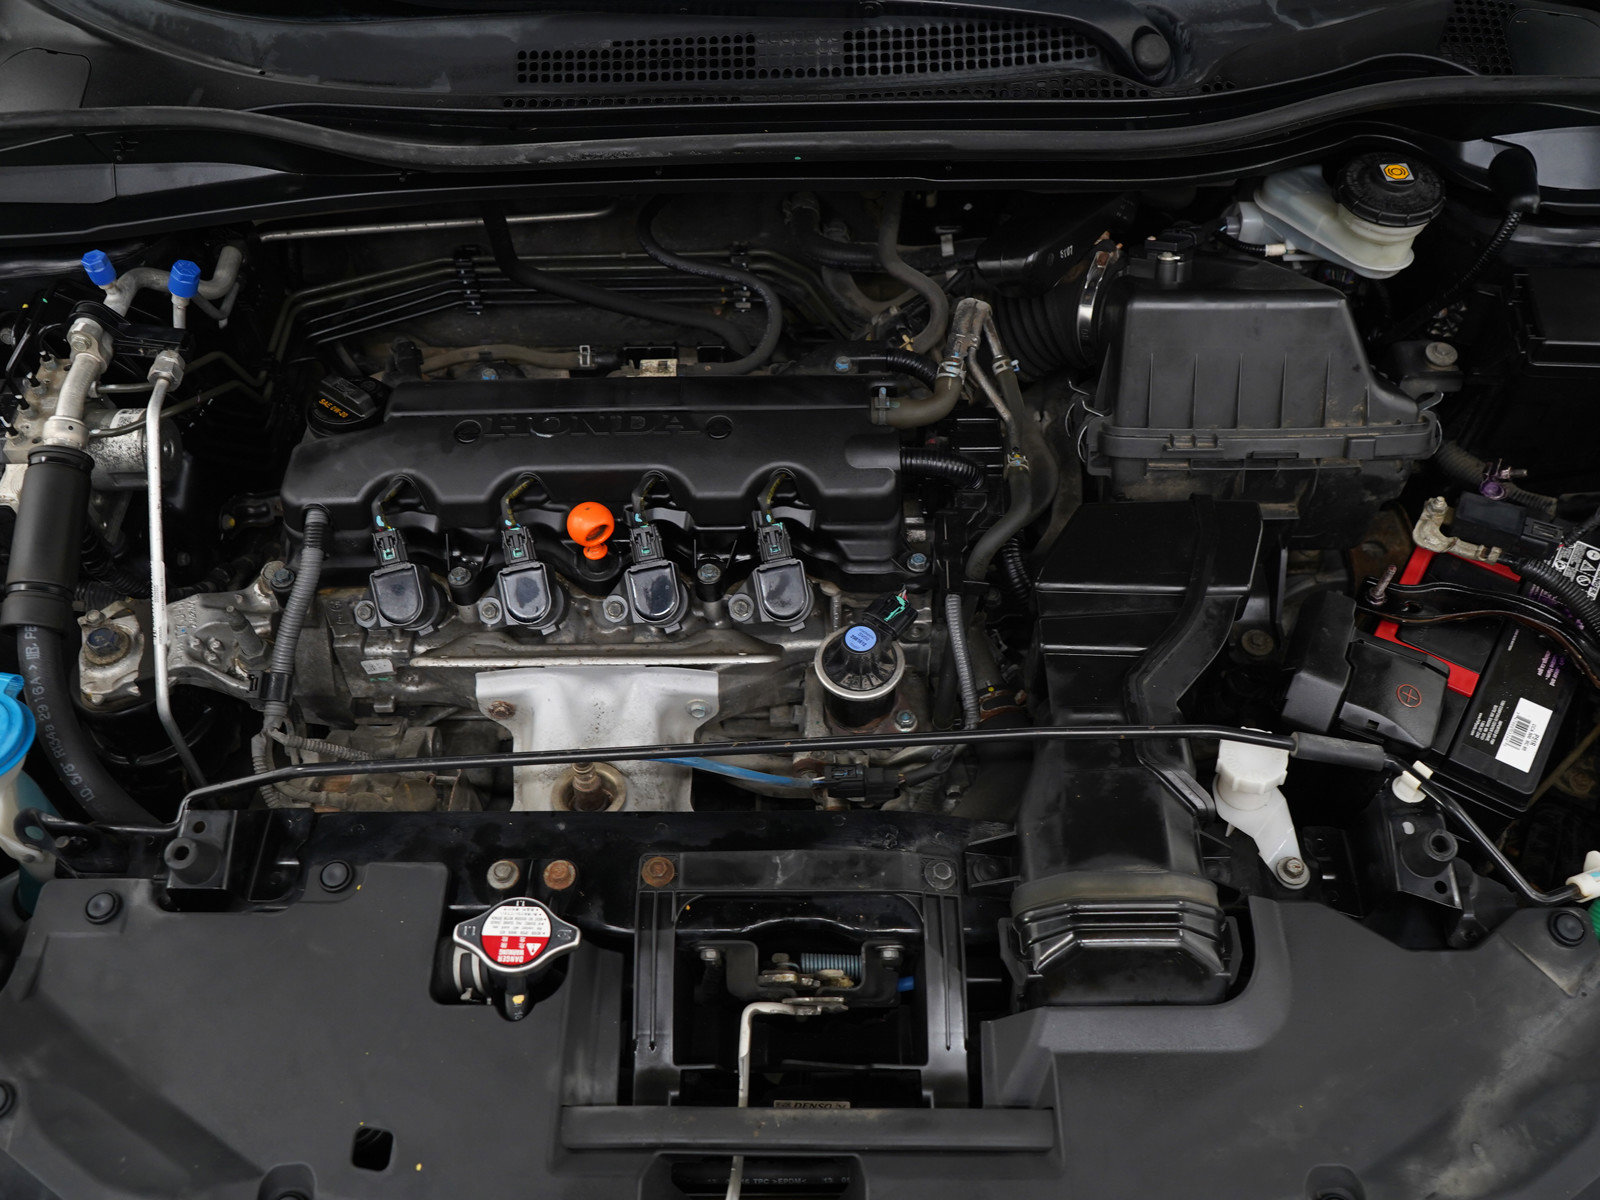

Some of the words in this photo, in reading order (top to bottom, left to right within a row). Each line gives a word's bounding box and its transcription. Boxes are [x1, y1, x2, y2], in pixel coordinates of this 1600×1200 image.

[318, 398, 333, 408] SAE
[484, 414, 701, 438] HONDA
[44, 724, 66, 758] R134a
[497, 955, 524, 963] DANGER
